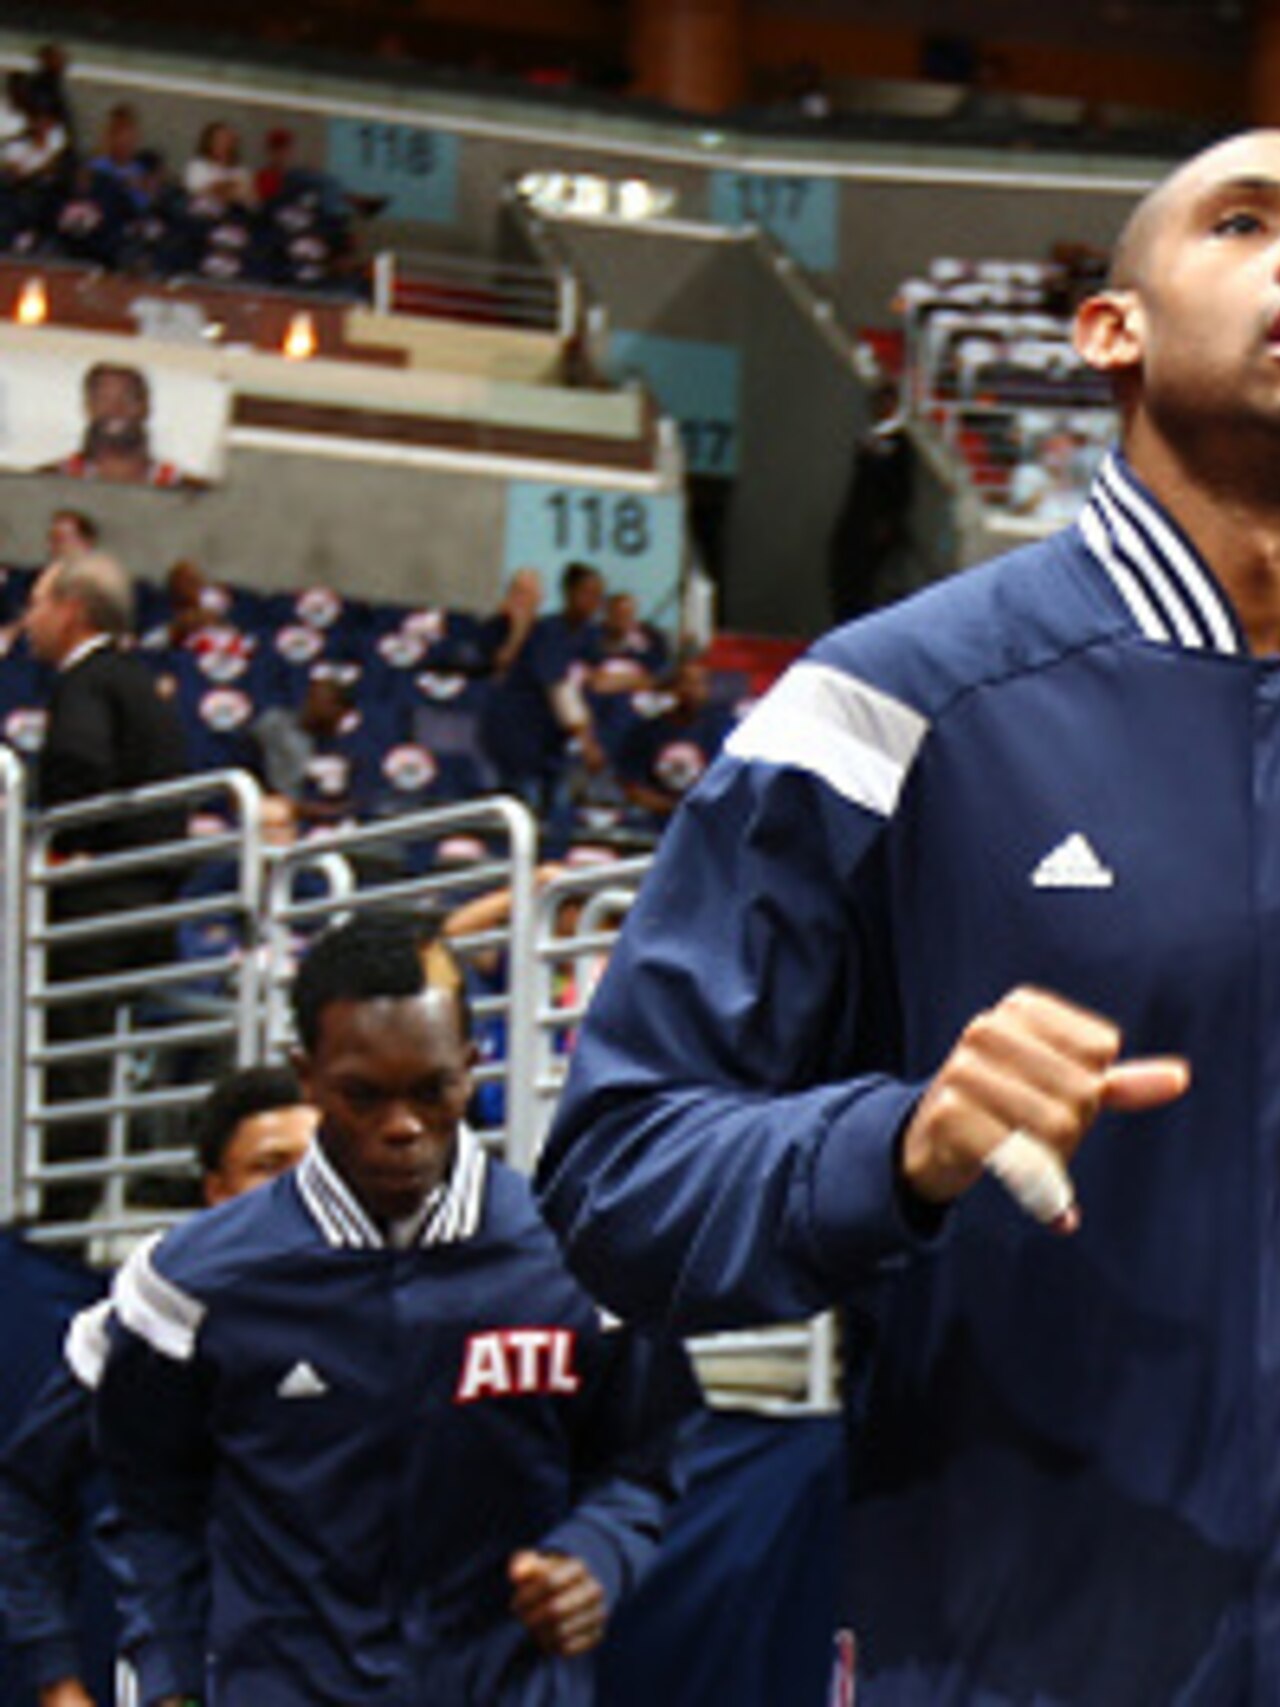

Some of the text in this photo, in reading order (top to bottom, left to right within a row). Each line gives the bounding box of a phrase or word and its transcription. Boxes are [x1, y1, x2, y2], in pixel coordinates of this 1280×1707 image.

[681, 419, 733, 468] 17
[545, 493, 651, 556] 118
[453, 1325, 584, 1405] ATL
